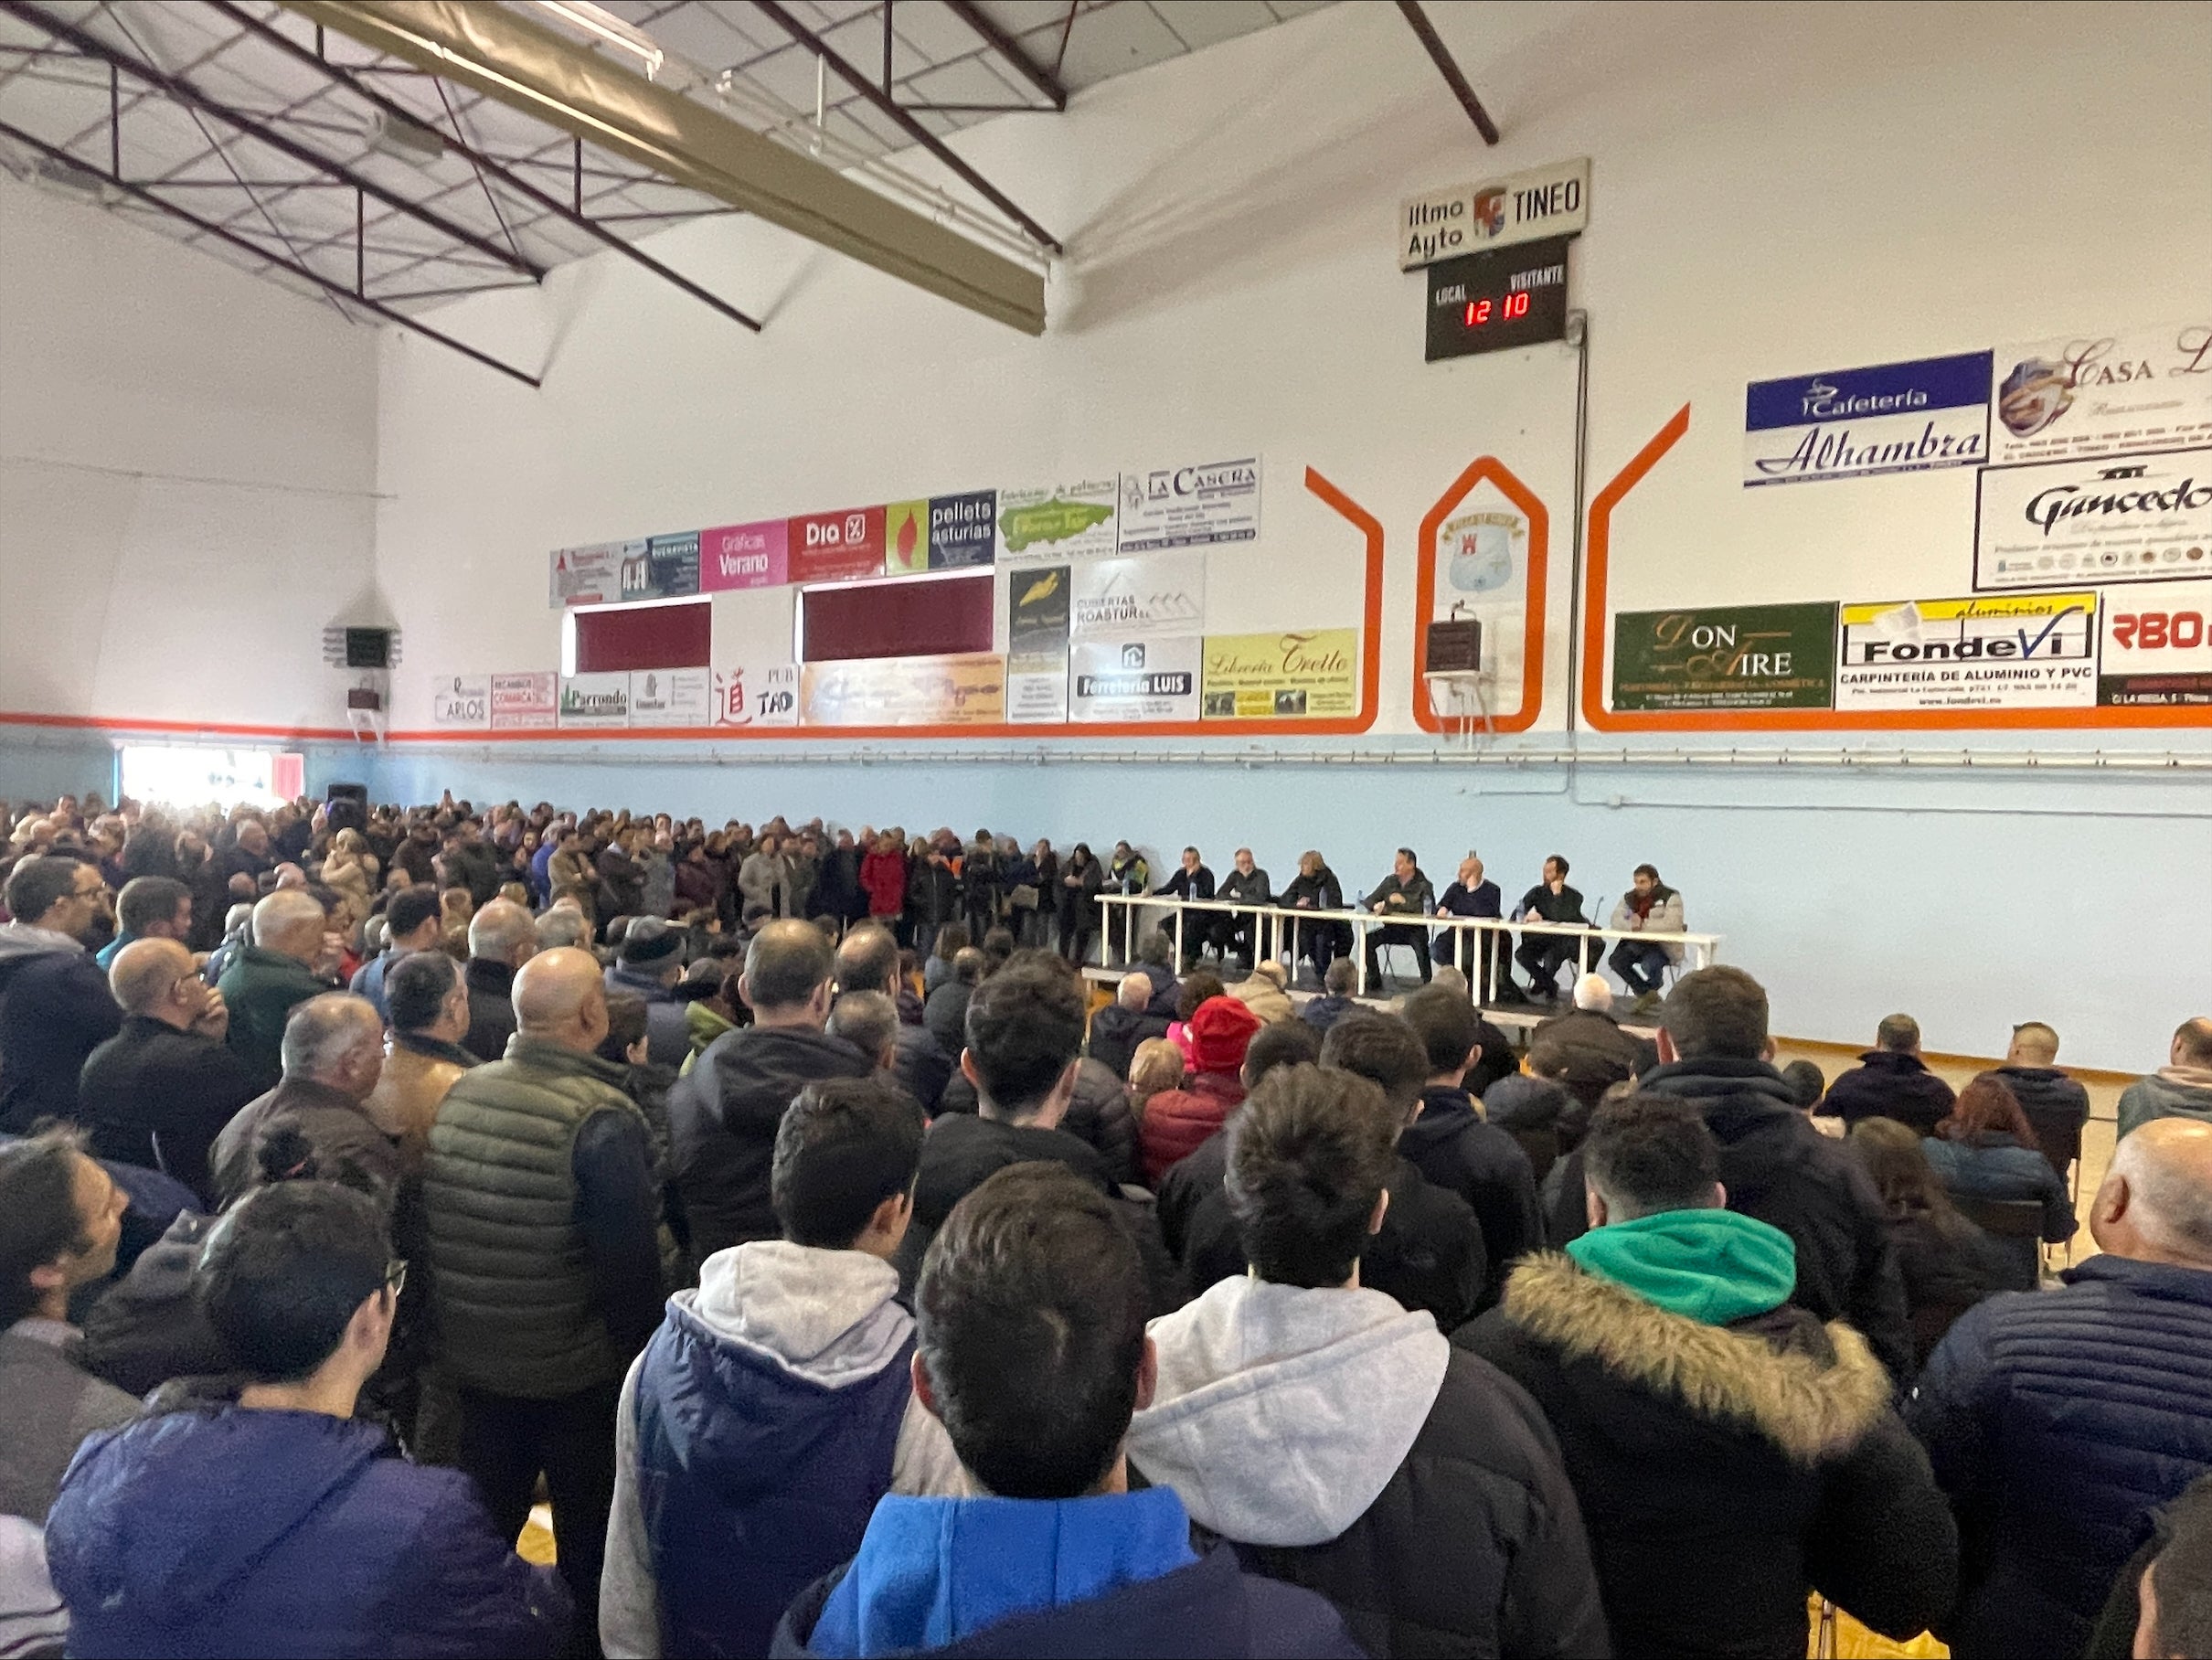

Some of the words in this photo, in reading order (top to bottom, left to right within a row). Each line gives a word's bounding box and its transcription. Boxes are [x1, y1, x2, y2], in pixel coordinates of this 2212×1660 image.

[1514, 179, 1580, 225] TINEO
[1409, 227, 1463, 260] Ayto
[1510, 264, 1564, 292] VISITANTE
[1436, 284, 1466, 306] LOCAL
[1465, 299, 1492, 326] 12
[1504, 292, 1528, 320] 10
[2063, 337, 2154, 388] CASA
[1755, 420, 1982, 474] Alhambra
[932, 501, 992, 529] pellets
[2026, 478, 2212, 537] Gancedo
[931, 523, 992, 545] asturias
[718, 553, 769, 577] Verano
[1154, 675, 1185, 693] LUIS
[1840, 670, 1935, 684] CARPINTERÍA
[1941, 670, 1960, 682] DE
[1964, 668, 2040, 681] ALUMINIO
[2046, 667, 2056, 678] Y
[2061, 666, 2092, 678] PVC
[572, 689, 627, 708] Parrondo
